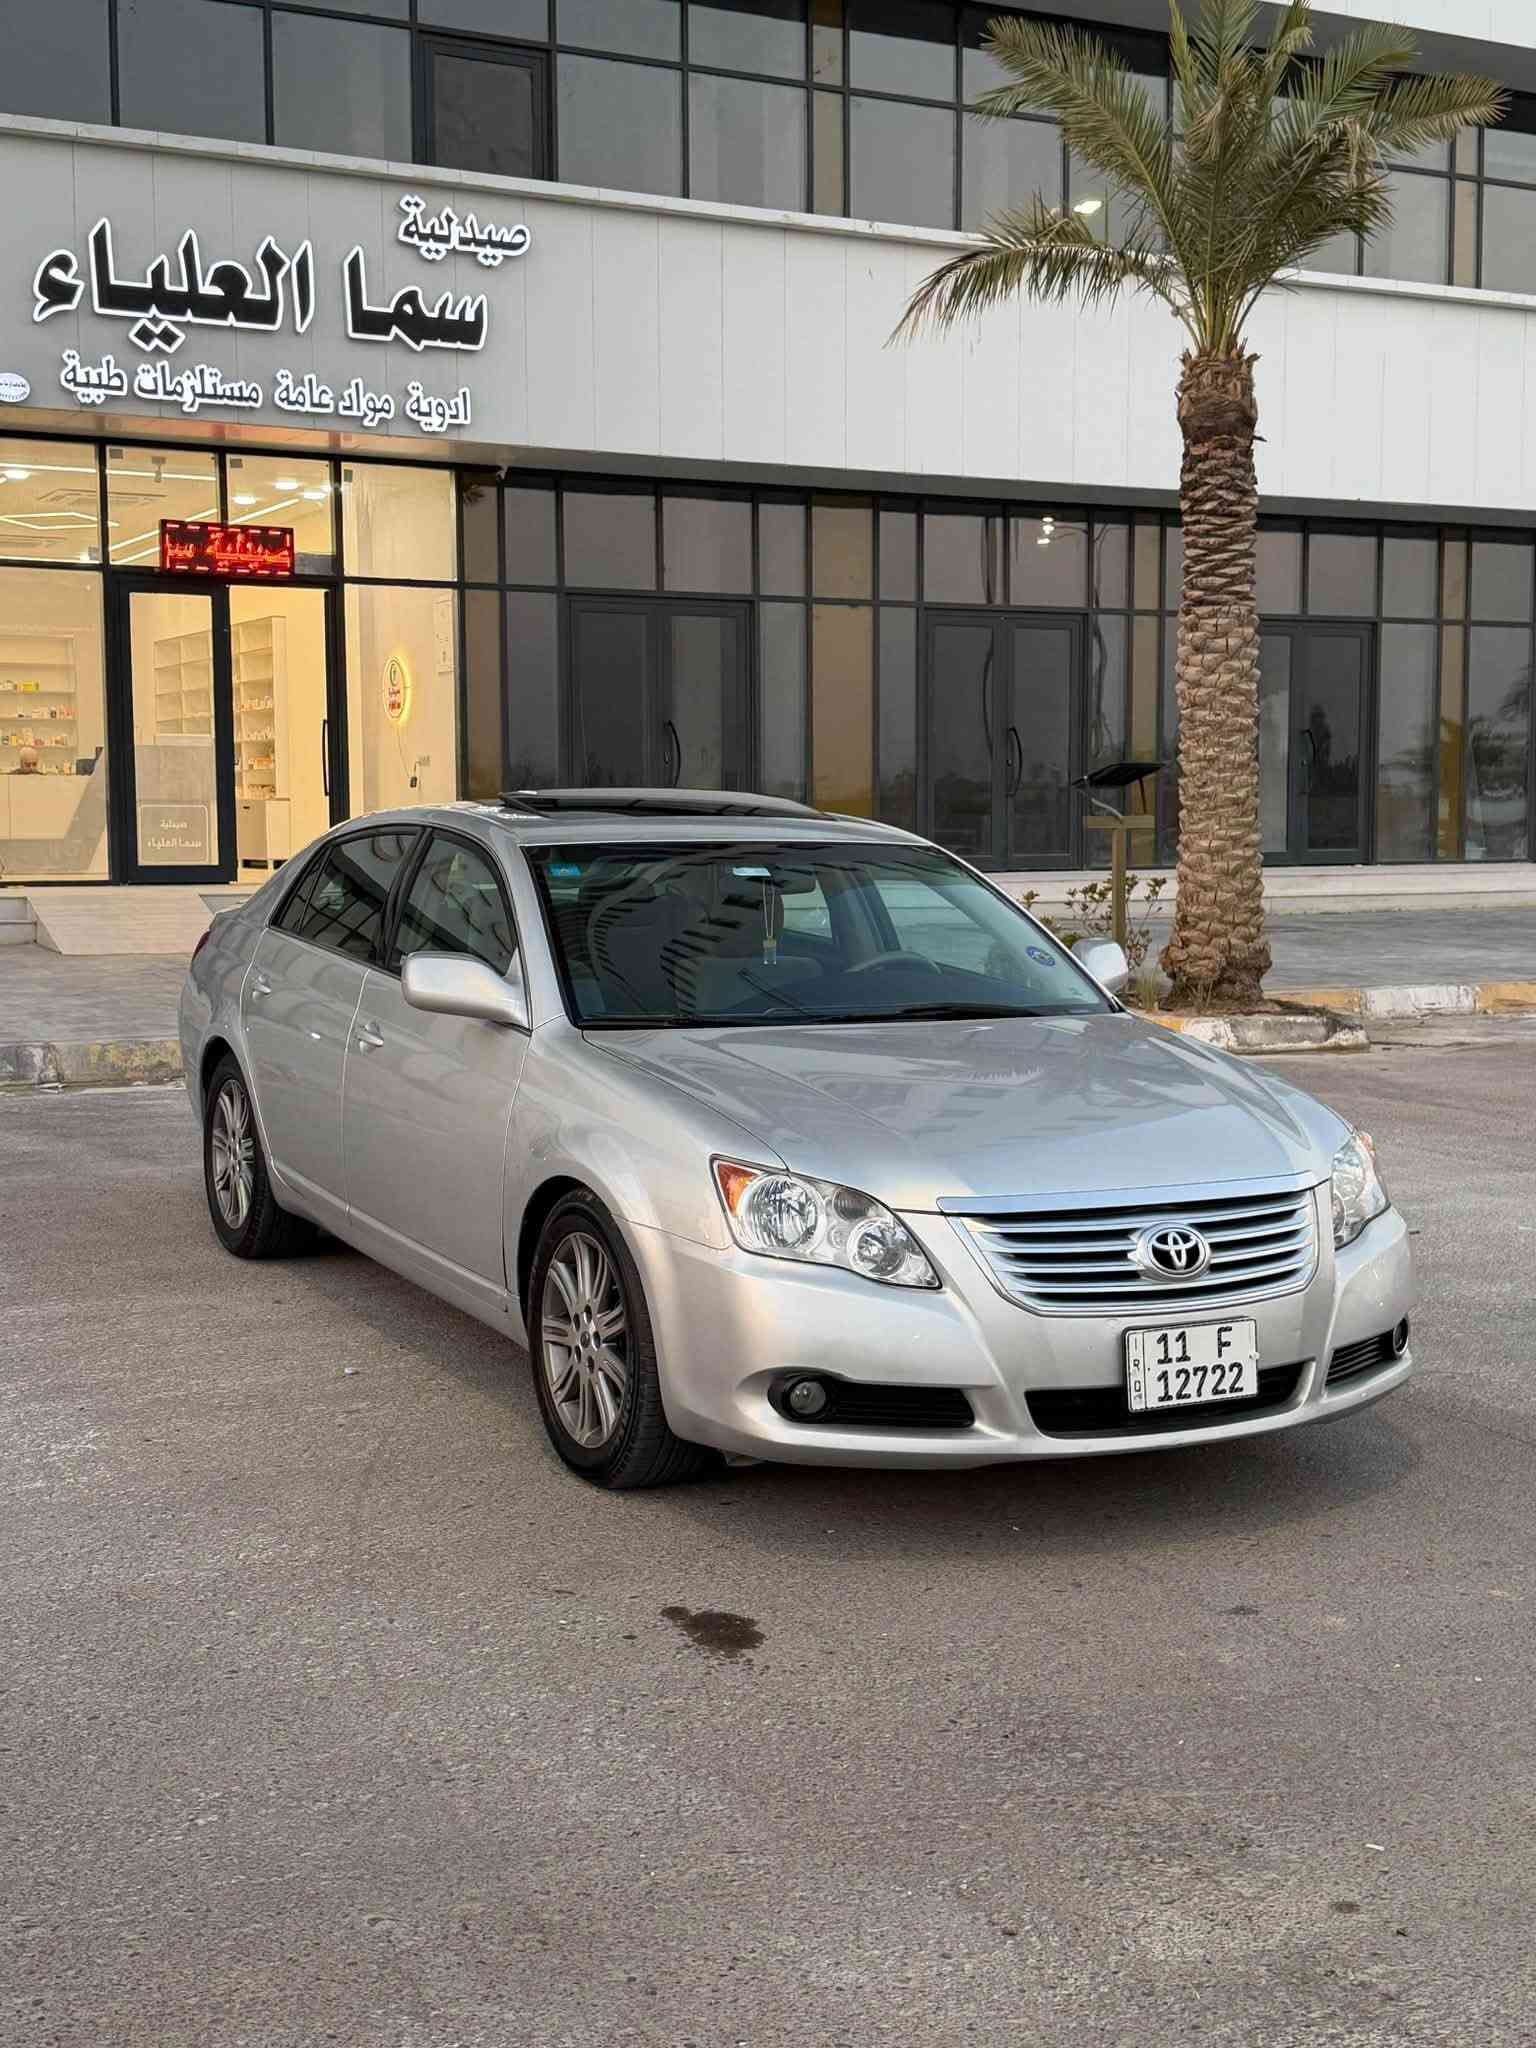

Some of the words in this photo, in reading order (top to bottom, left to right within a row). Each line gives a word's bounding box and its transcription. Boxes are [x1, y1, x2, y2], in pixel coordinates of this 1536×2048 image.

[399, 195, 530, 266] صيدلية
[34, 217, 314, 353] العلياء
[343, 247, 488, 351] سما
[61, 351, 127, 404] طبية
[135, 362, 262, 413] مستلزمات
[275, 370, 334, 413] عامة
[339, 379, 394, 425] مواد
[404, 382, 471, 431] ادوية
[1157, 1331, 1191, 1364] 11
[1217, 1326, 1233, 1358] F
[1157, 1362, 1244, 1402] 12722
